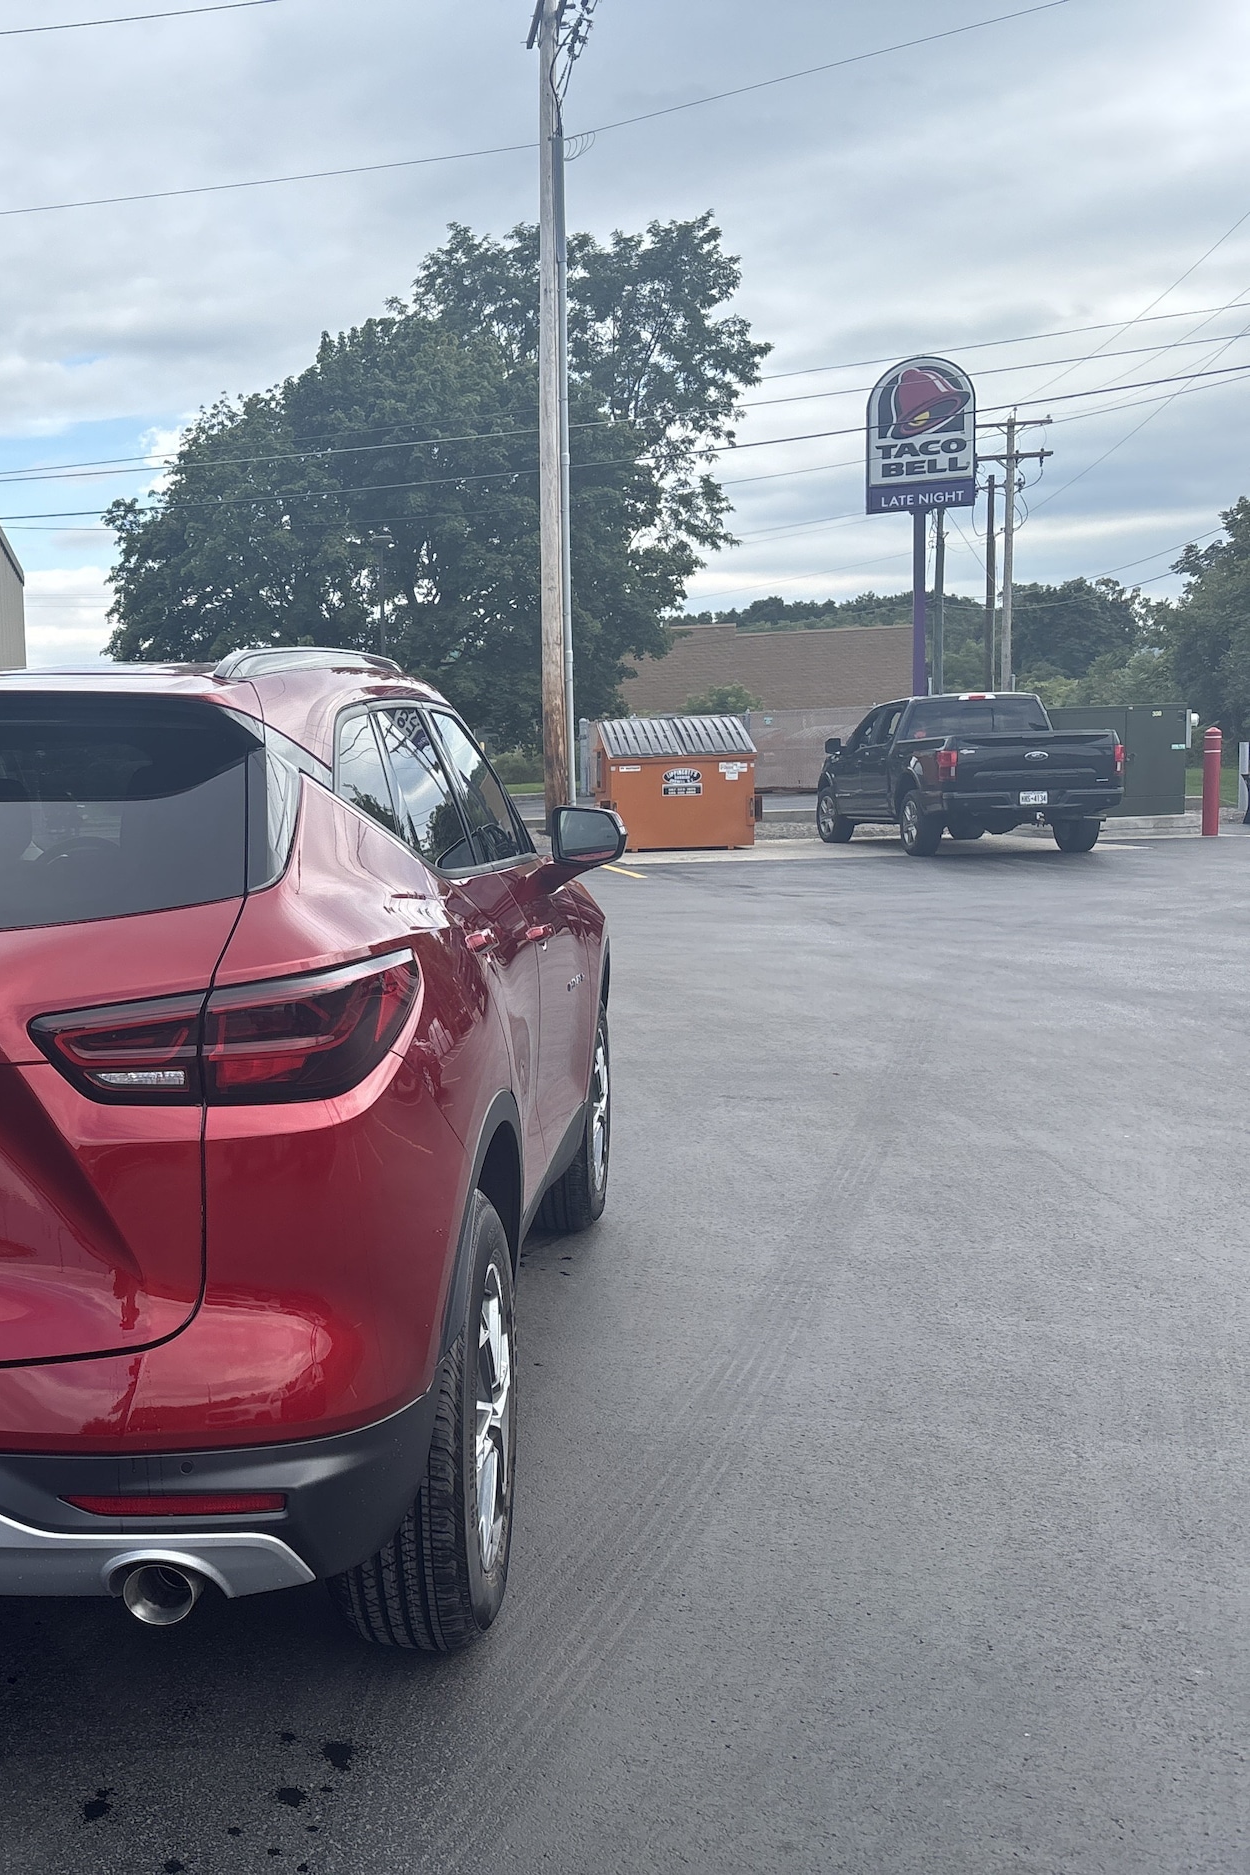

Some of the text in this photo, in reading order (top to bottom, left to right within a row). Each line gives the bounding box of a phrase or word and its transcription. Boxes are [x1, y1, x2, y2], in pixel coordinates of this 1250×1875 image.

[875, 438, 967, 460] TACO
[881, 457, 970, 478] BELL
[881, 490, 965, 508] LATE NIGHT
